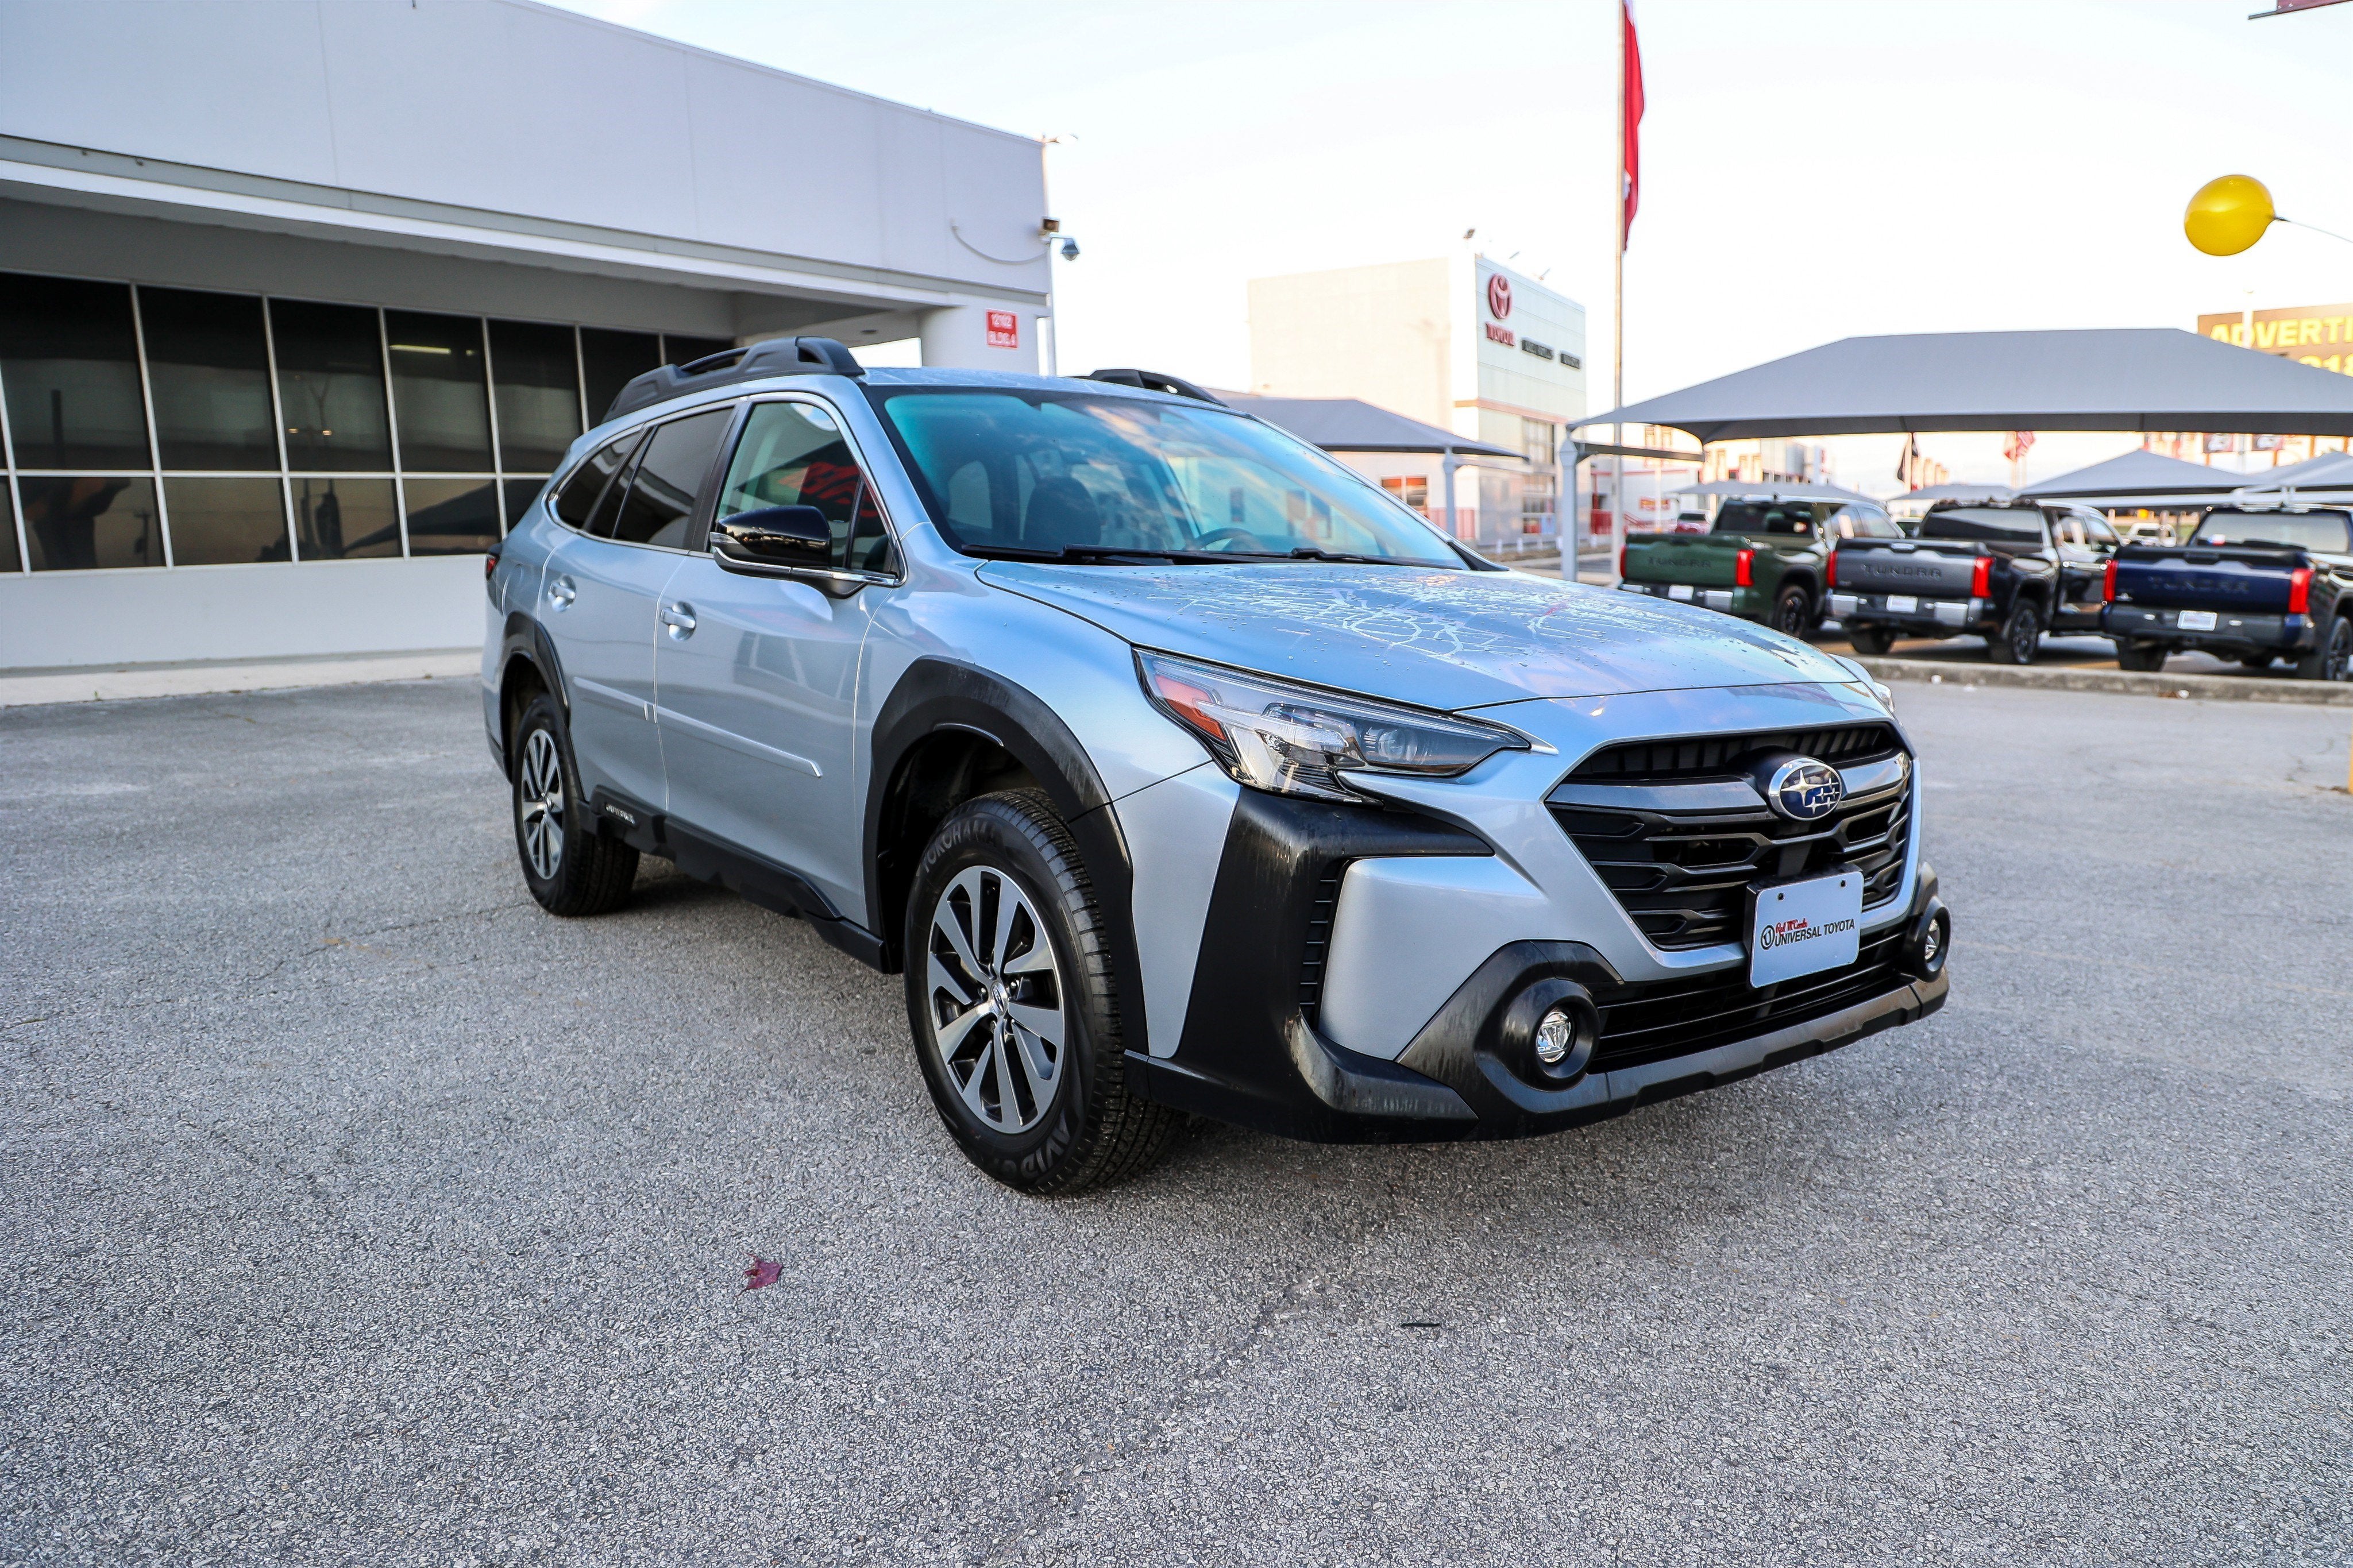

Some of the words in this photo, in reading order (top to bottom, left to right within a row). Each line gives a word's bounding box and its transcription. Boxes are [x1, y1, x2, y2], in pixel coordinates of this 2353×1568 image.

[1648, 556, 1712, 569] TUNDRA
[1864, 565, 1943, 580] TUNDRA
[1775, 926, 1822, 947] UNIVERSAL
[1823, 918, 1856, 935] TOYOTA
